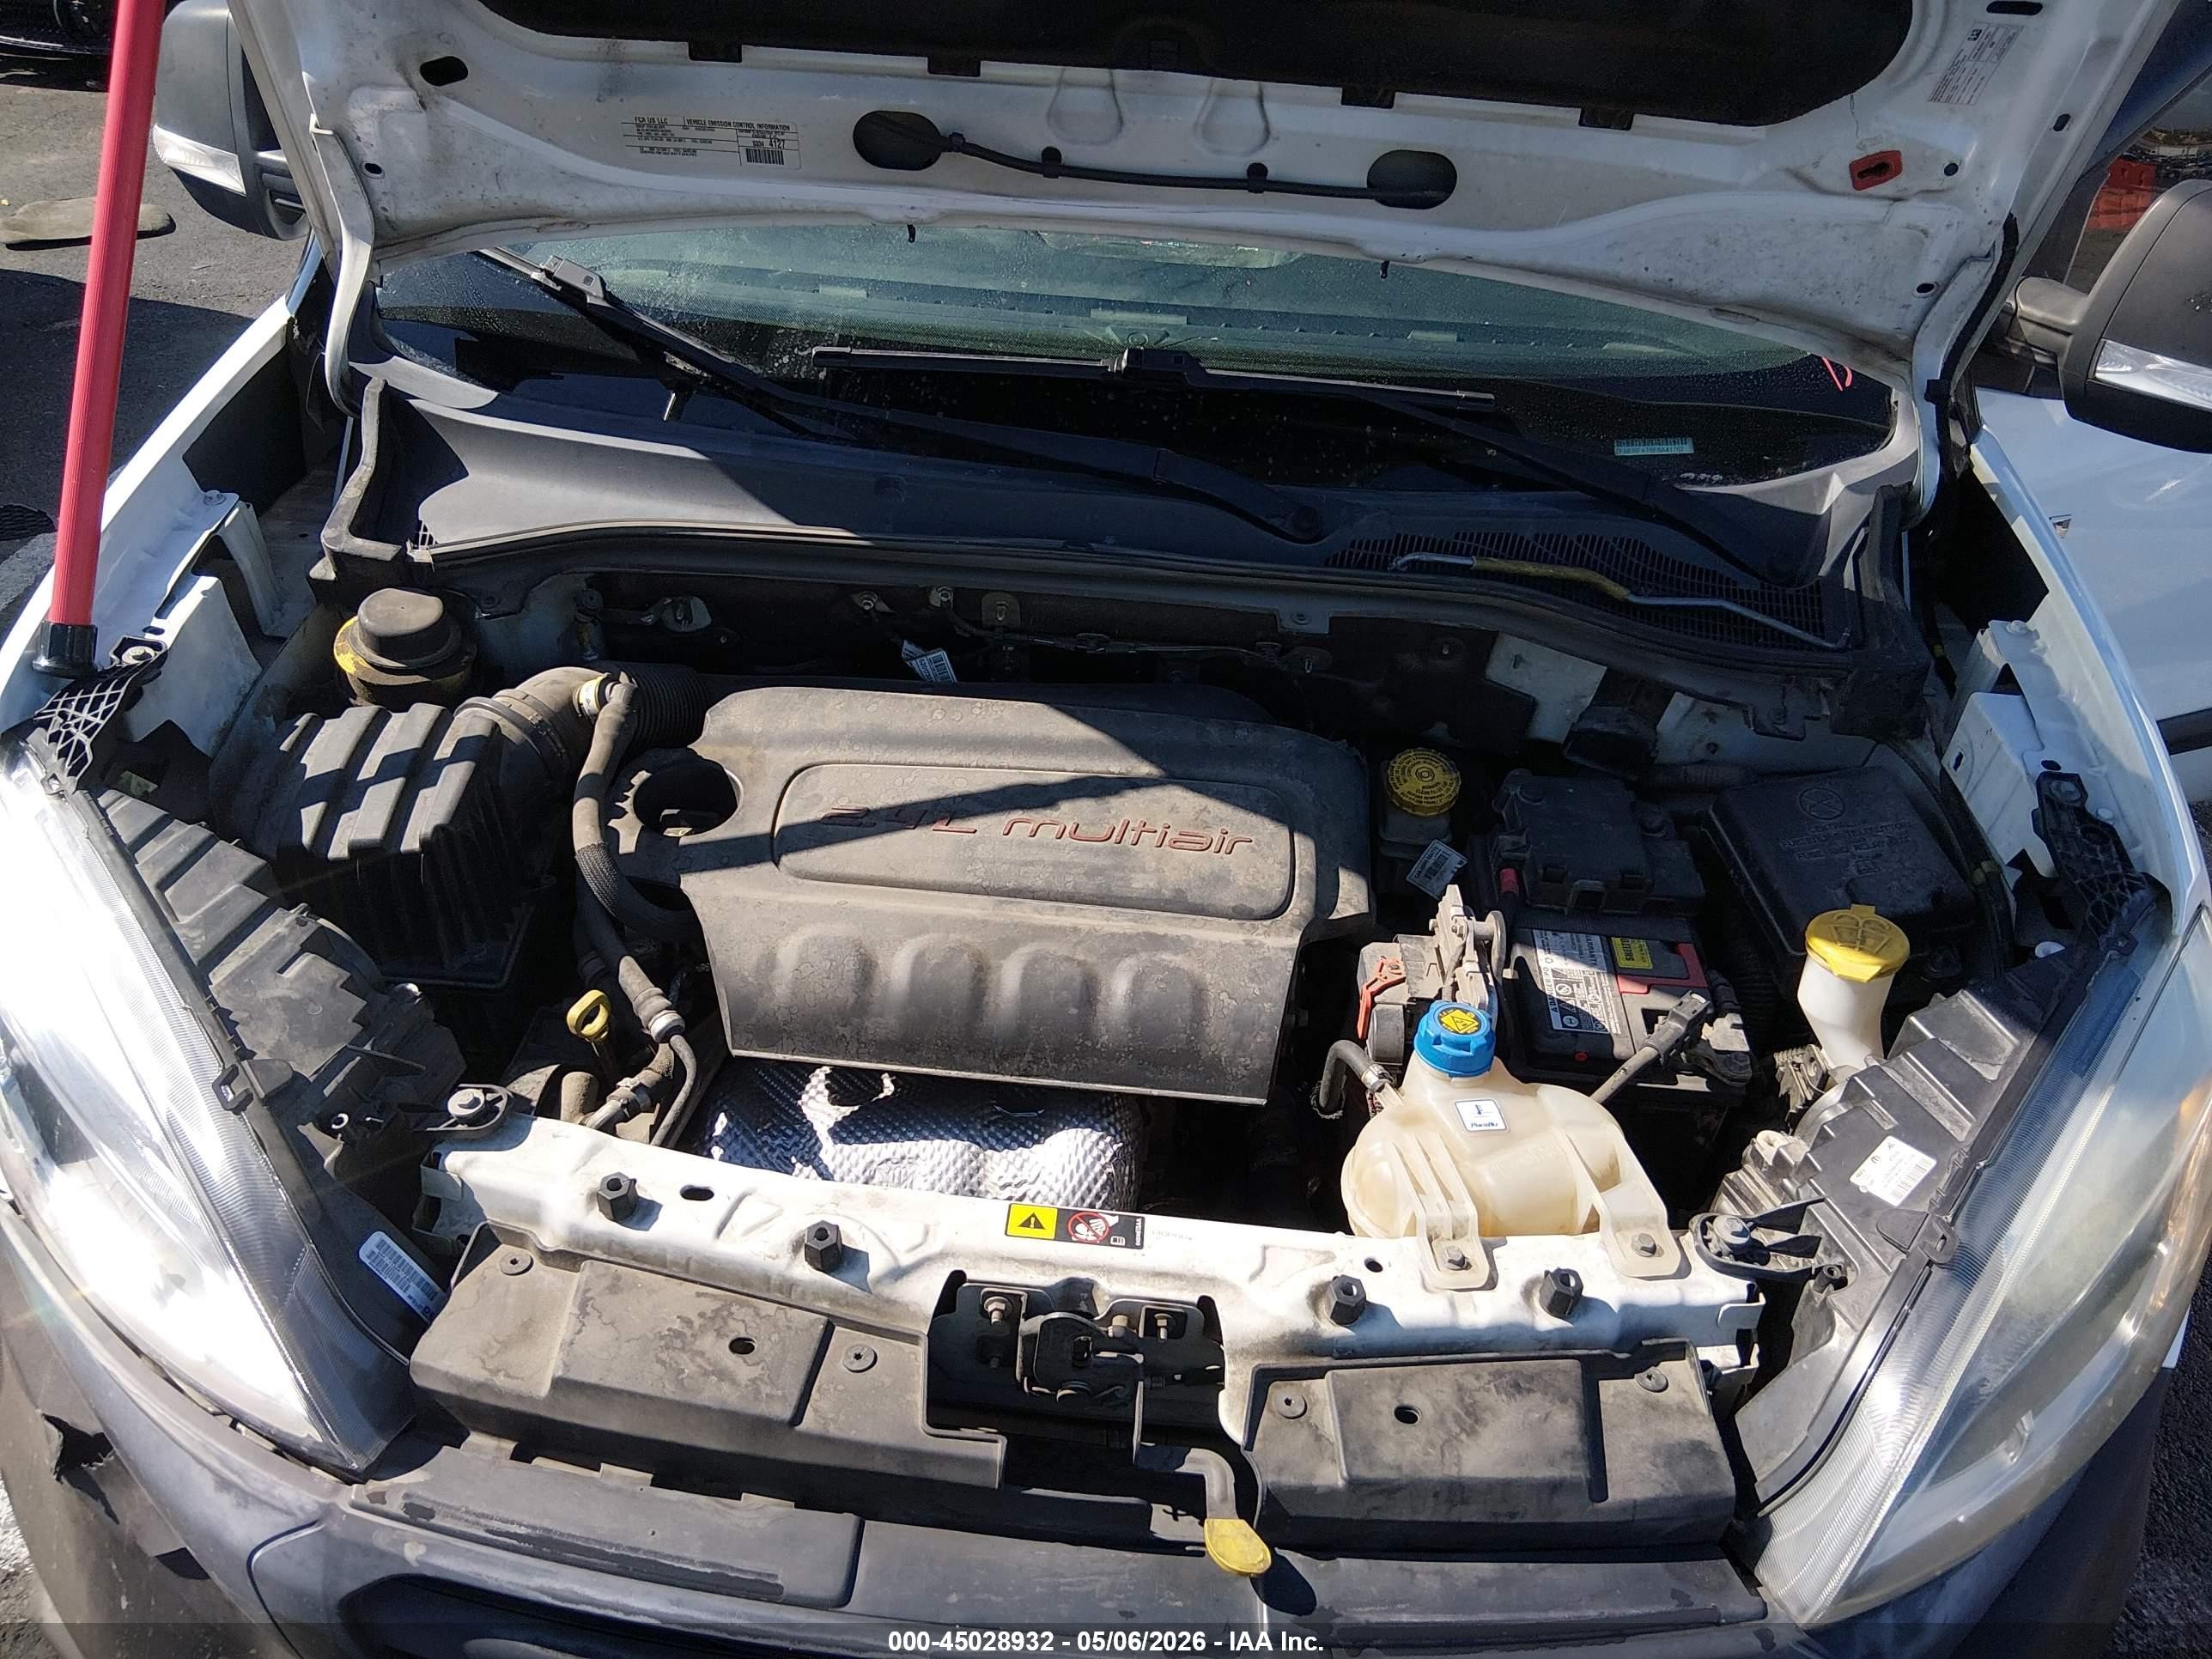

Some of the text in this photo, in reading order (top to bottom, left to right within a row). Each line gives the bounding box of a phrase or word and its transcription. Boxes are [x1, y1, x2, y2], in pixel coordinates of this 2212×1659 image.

[756, 123, 790, 131] INFORMATION
[769, 139, 786, 149] 4127
[1001, 817, 1253, 855] multiair
